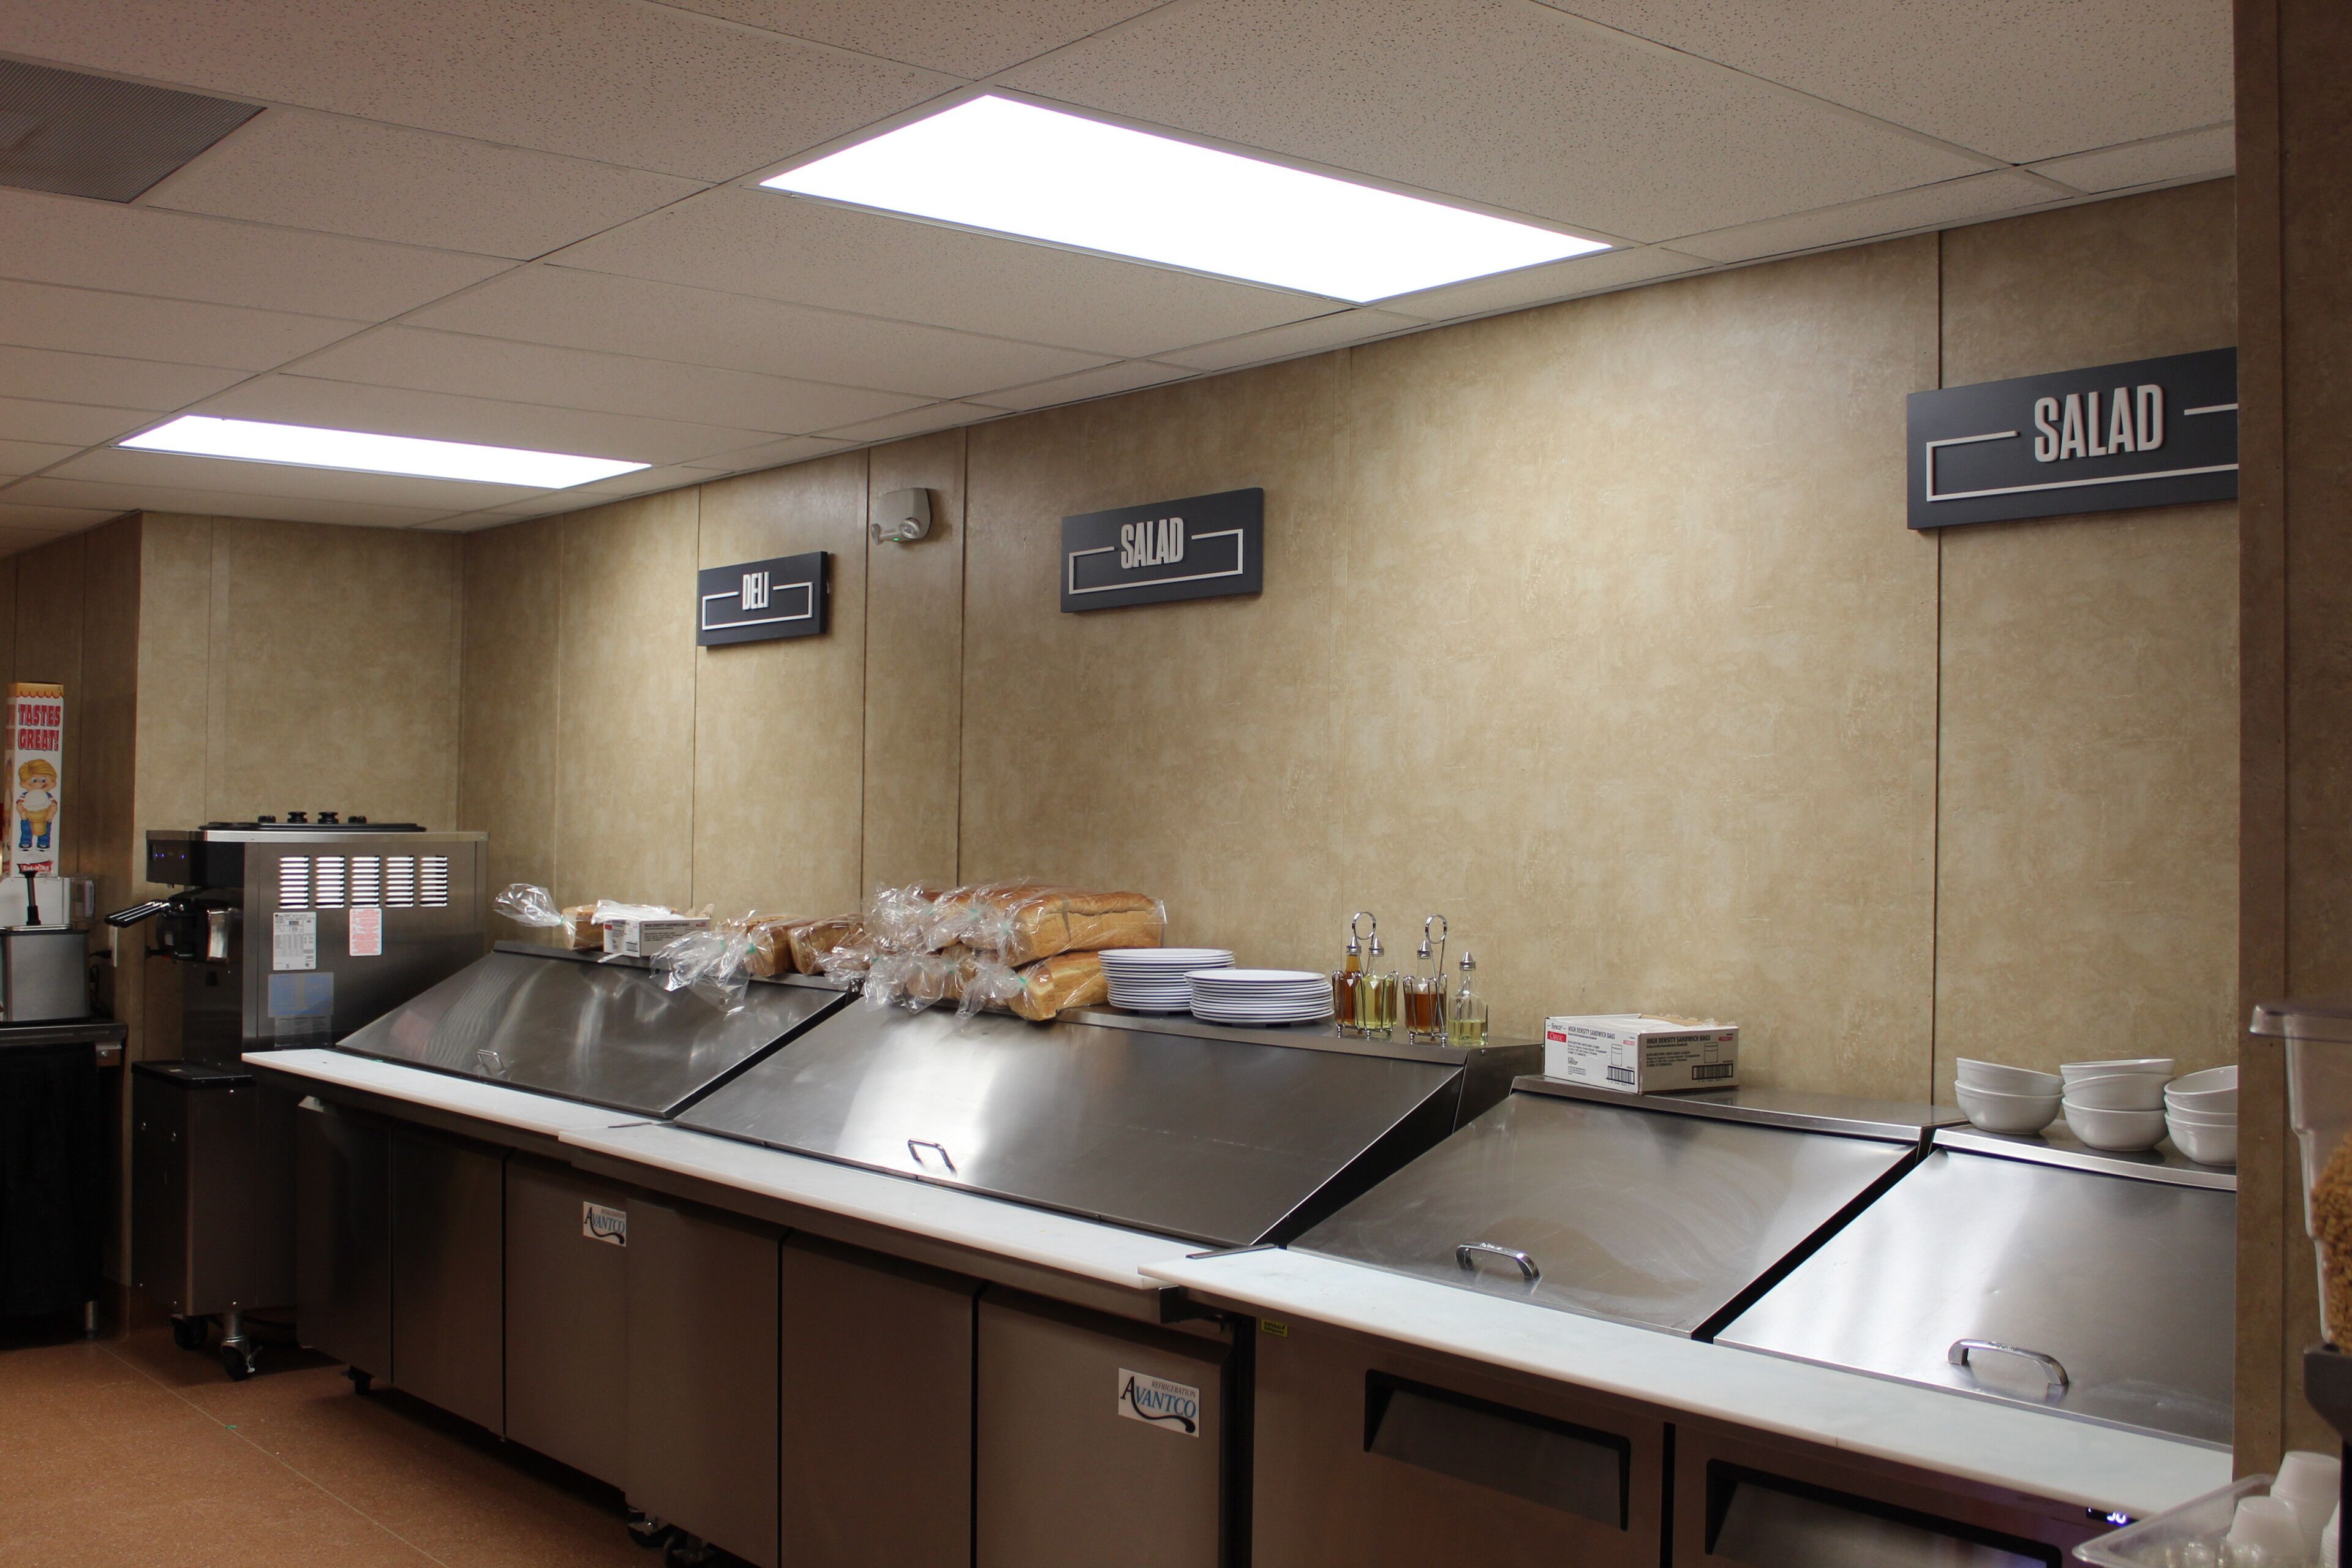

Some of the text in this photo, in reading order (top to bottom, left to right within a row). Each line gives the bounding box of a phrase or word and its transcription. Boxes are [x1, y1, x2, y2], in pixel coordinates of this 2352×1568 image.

[2034, 383, 2164, 462] SALAD
[1121, 517, 1184, 569] SALAD
[742, 571, 769, 611] DELI
[18, 704, 61, 726] TASTES
[18, 728, 59, 752] GREAT!
[1550, 1032, 1563, 1042] Classic
[584, 1207, 625, 1244] AVANTCO
[1120, 1376, 1196, 1433] AVANTCO
[1152, 1381, 1197, 1398] REFRIGERATION
